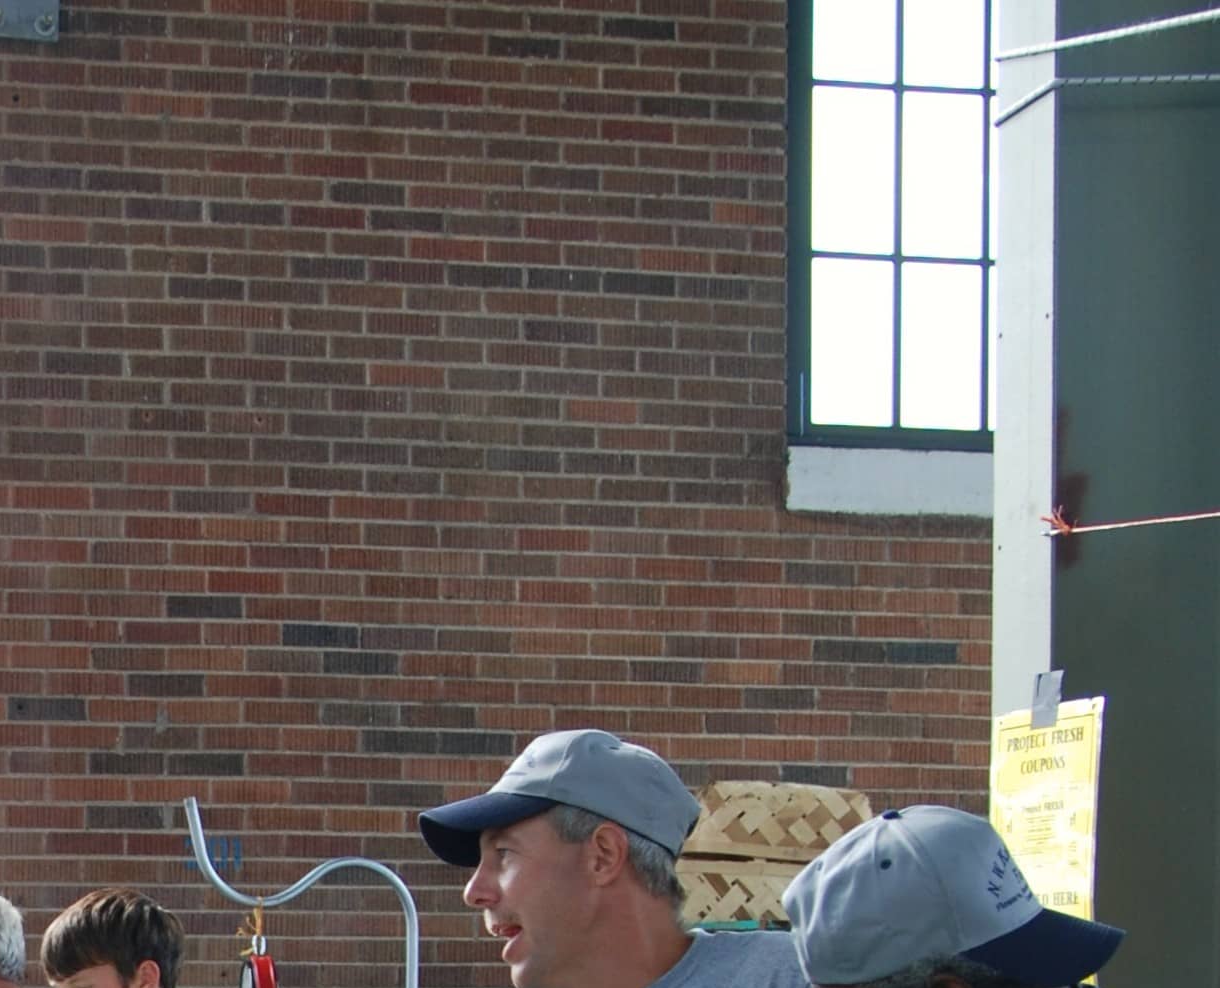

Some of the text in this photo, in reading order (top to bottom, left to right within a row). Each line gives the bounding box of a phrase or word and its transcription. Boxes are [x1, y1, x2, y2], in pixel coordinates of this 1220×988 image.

[1007, 726, 1084, 752] PROJECT FRESH
[1020, 756, 1066, 775] COUPONS
